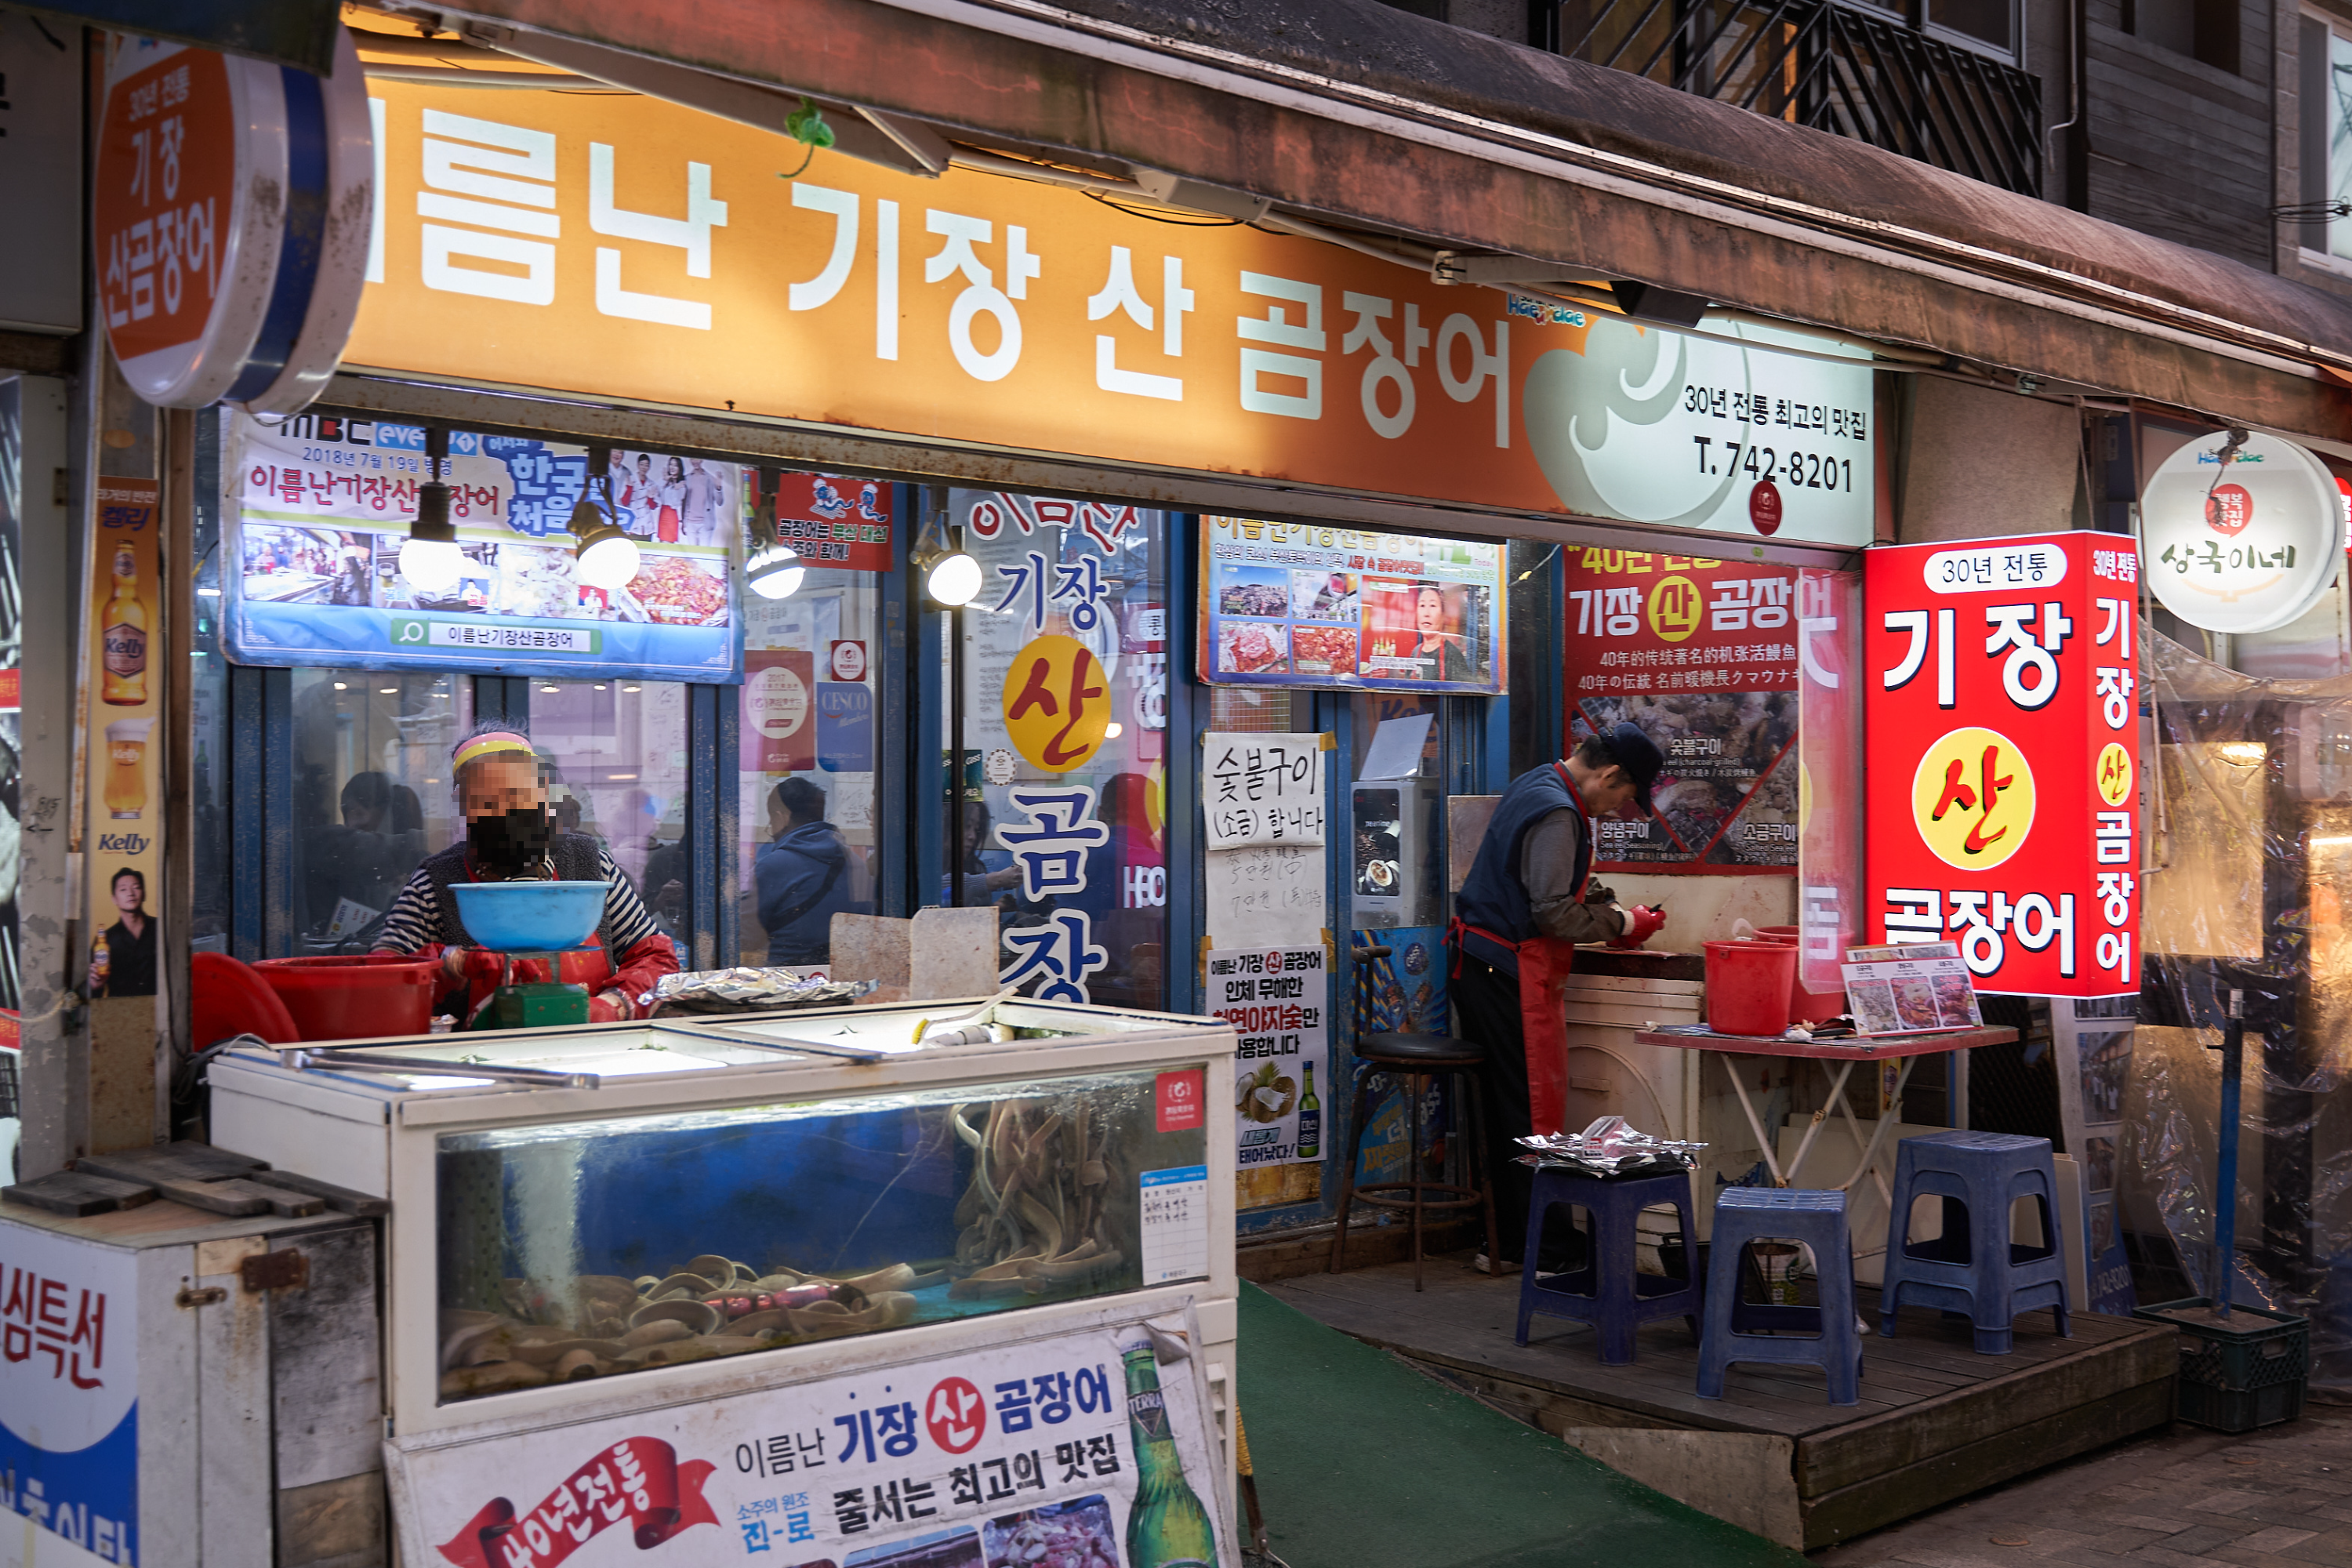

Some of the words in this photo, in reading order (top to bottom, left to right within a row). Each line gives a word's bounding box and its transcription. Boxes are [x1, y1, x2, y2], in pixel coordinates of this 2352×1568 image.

[128, 82, 157, 124] 30년
[162, 66, 191, 109] 전통
[130, 115, 185, 205] 기장
[107, 196, 216, 329] 산곰장어
[788, 182, 1041, 382] 기장
[1087, 245, 1195, 401] 산
[1237, 270, 1510, 449] 곰장어
[1684, 383, 1726, 420] 30년
[1732, 392, 1769, 425] 전통
[1775, 398, 1828, 434] 최고의
[1832, 408, 1867, 441] 맛집
[303, 446, 355, 467] 2018년
[361, 452, 383, 470] 7월
[389, 456, 419, 473] 19일
[250, 464, 499, 518] 이름난기장산장어
[102, 506, 151, 532] 켈리
[778, 518, 830, 539] 곰장어는
[831, 522, 858, 542] 부산
[858, 524, 889, 543] 대선
[818, 542, 851, 561] 함께!
[2093, 550, 2116, 581] 30년
[2116, 551, 2137, 583] 전통
[2161, 540, 2296, 574] 상국이네
[1941, 556, 1994, 585] 30년
[2002, 552, 2049, 583] 전통
[996, 550, 1111, 634] 기장
[1570, 586, 1643, 637] 기장
[1657, 583, 1693, 633] 산
[104, 637, 145, 659] Kelly
[448, 626, 574, 648] 이름난기장산곰장어
[1883, 601, 2074, 711] 기장
[822, 691, 868, 710] CESCO
[1008, 648, 1104, 767] 산
[1670, 738, 1722, 756] 숯불구이
[2101, 748, 2126, 800] 산
[1932, 744, 2014, 855] 산
[1214, 808, 1259, 839] (소금)
[1268, 807, 1323, 839] 합니다
[1601, 821, 1650, 839] 양념구이
[1742, 823, 1796, 842] 소금구이
[98, 833, 151, 856] Kelly
[2096, 811, 2135, 985] 곰장어
[1884, 886, 2076, 979] 곰장어
[1210, 954, 1236, 976] 이름난
[1239, 953, 1264, 975] 기장
[1267, 953, 1282, 971] 산
[1283, 950, 1322, 971] 곰장어
[1225, 979, 1255, 1003] 인체
[1258, 976, 1304, 1000] 무해한
[1239, 1143, 1297, 1165] 태어났다!
[0, 1263, 107, 1390] 심특선
[1128, 1391, 1164, 1414] TERRA
[735, 1428, 826, 1479] 이름난
[833, 1401, 919, 1464] 기장
[931, 1385, 978, 1446] 산
[995, 1363, 1113, 1435] 곰장어
[833, 1478, 938, 1535] 줄서는
[949, 1450, 1047, 1508] 최고의
[1055, 1433, 1120, 1484] 맛집
[503, 1441, 650, 1568] 40년전통
[736, 1497, 778, 1522] 소주의
[781, 1491, 811, 1512] 원조
